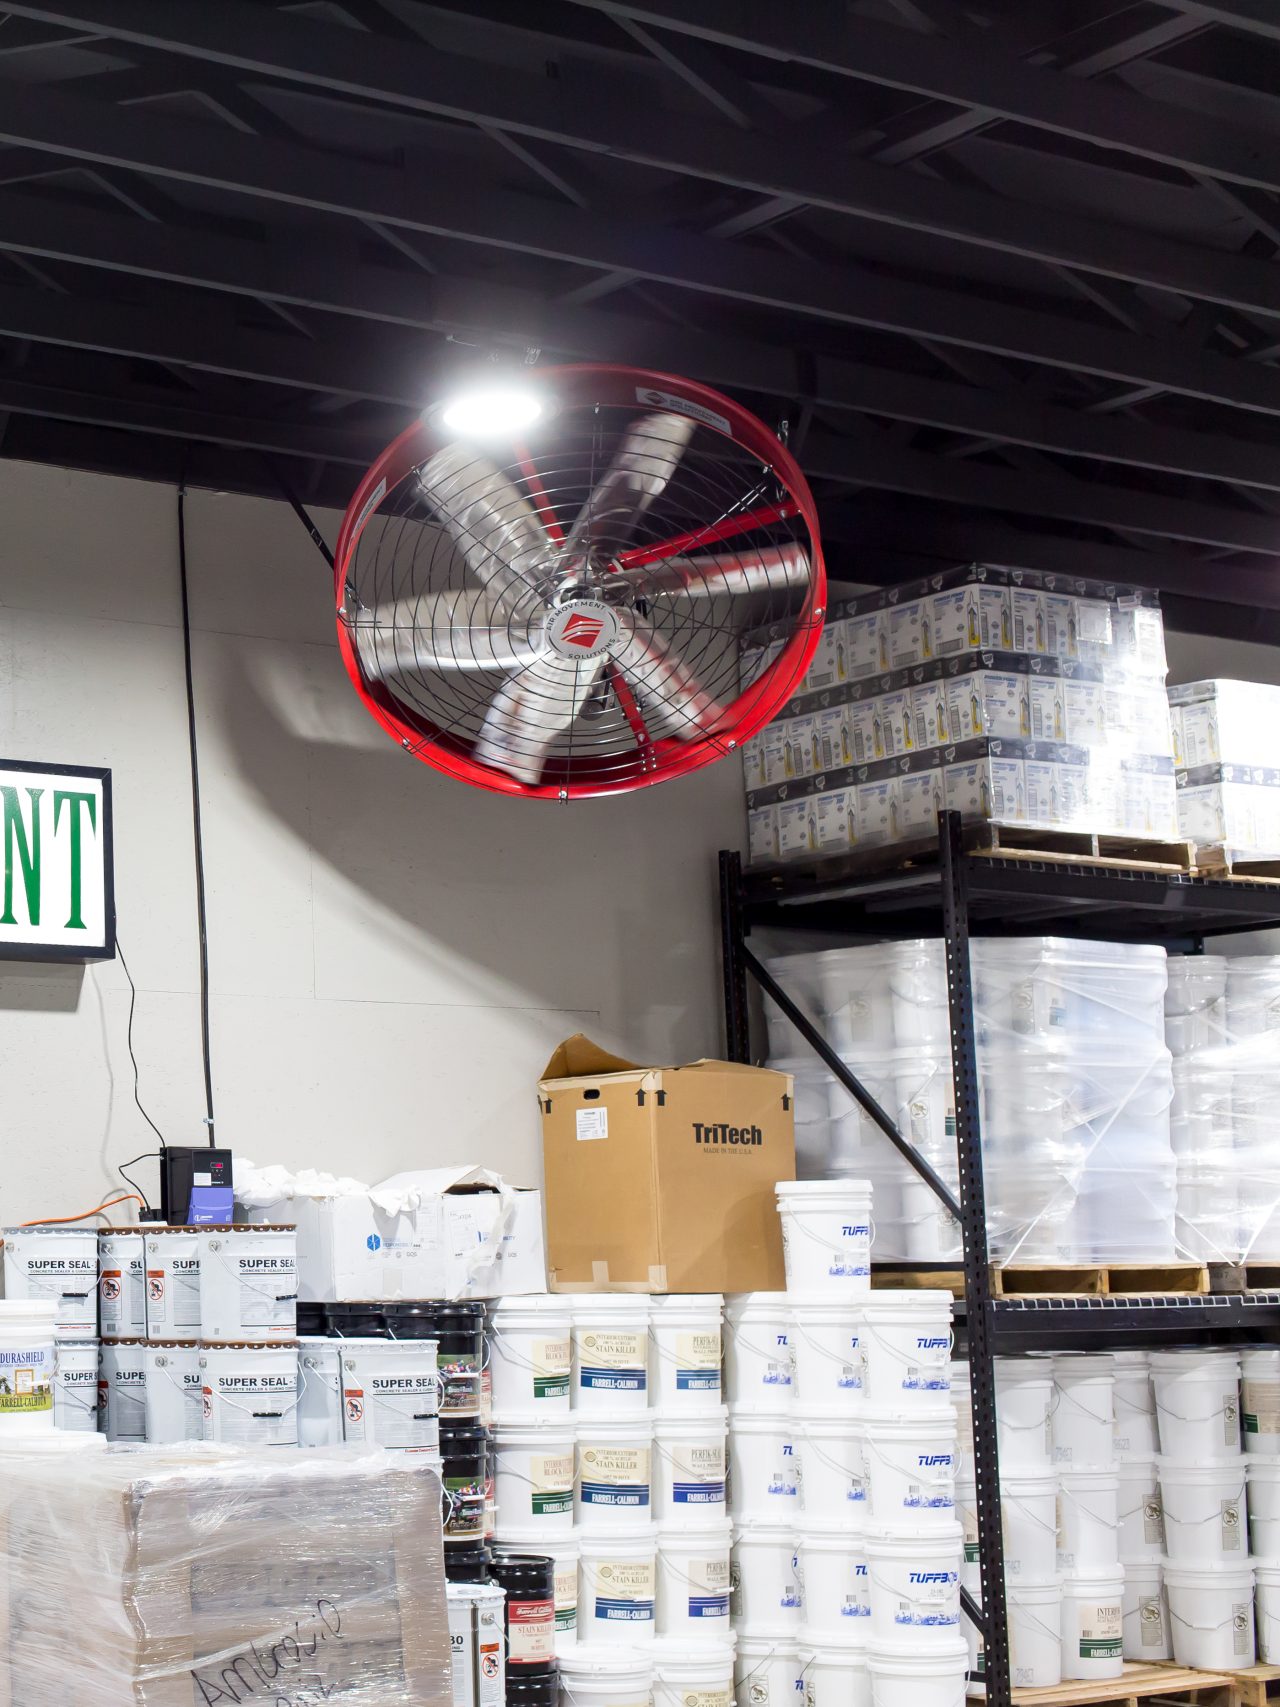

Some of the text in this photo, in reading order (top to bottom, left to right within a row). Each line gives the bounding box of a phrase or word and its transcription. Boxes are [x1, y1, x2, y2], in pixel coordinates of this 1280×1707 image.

[555, 601, 606, 615] MOVEMENT
[567, 638, 616, 660] SOLUTIONS
[692, 1123, 762, 1145] TriTech
[28, 1261, 97, 1269] SUPER SEAL-
[239, 1259, 277, 1268] SUPER
[917, 1338, 951, 1349] TUFFB
[615, 1346, 637, 1354] KILLER
[0, 1351, 45, 1364] DURASHIELD
[64, 1373, 93, 1381] SUPER
[219, 1377, 297, 1387] SUPER SEAL-
[372, 1379, 413, 1388] SUPER
[591, 1377, 638, 1389] FARRELL-CALHOUN
[596, 1461, 637, 1470] STAIN KILLER
[918, 1455, 954, 1466] TUFFB
[591, 1493, 639, 1505] FARRELL-CALHOUN
[612, 1576, 649, 1584] STAIN KILLER
